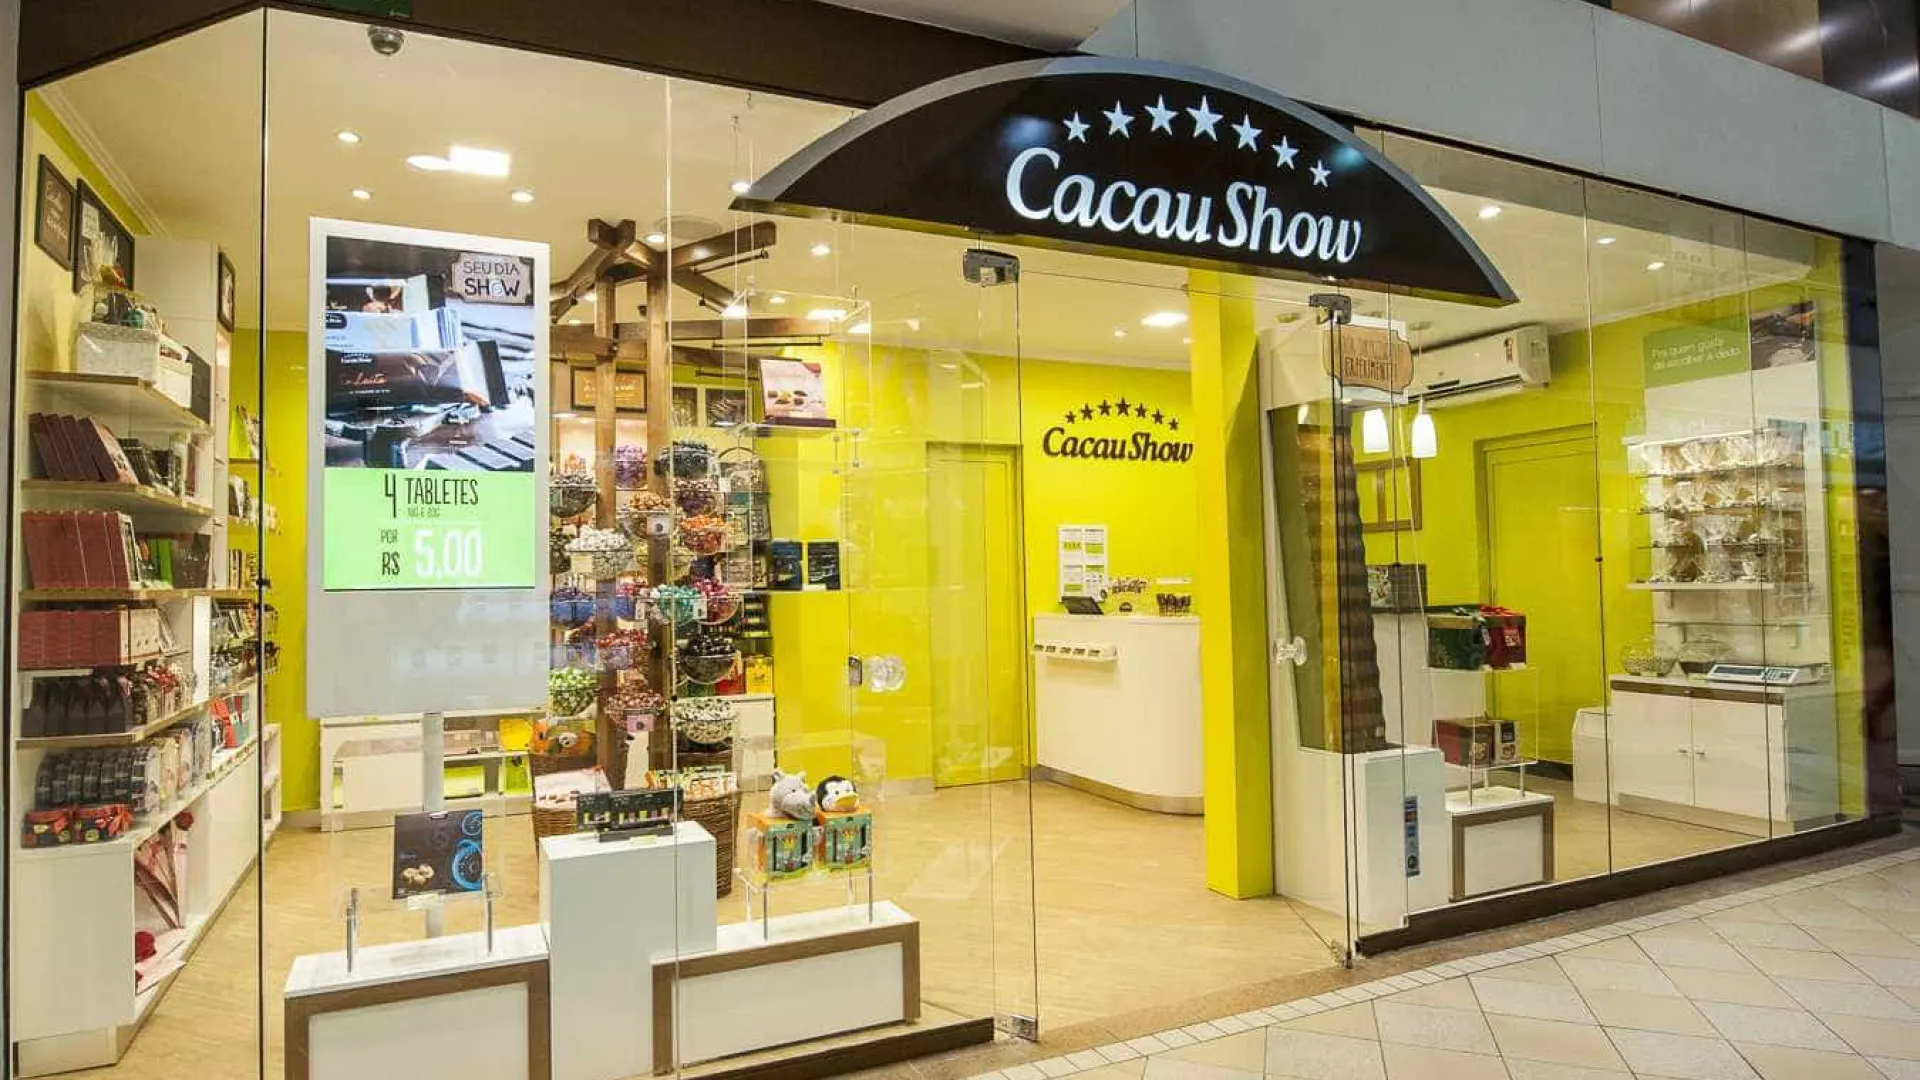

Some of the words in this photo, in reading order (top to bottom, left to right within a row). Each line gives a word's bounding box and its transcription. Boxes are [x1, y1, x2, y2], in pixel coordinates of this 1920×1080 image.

[1006, 147, 1212, 242] Cacau
[1217, 181, 1362, 264] Show
[463, 261, 492, 275] SEU
[495, 263, 520, 276] DIA
[1043, 426, 1126, 459] Cacau
[1128, 431, 1193, 463] Show
[385, 473, 397, 518] 4
[404, 477, 478, 505] TABLETES
